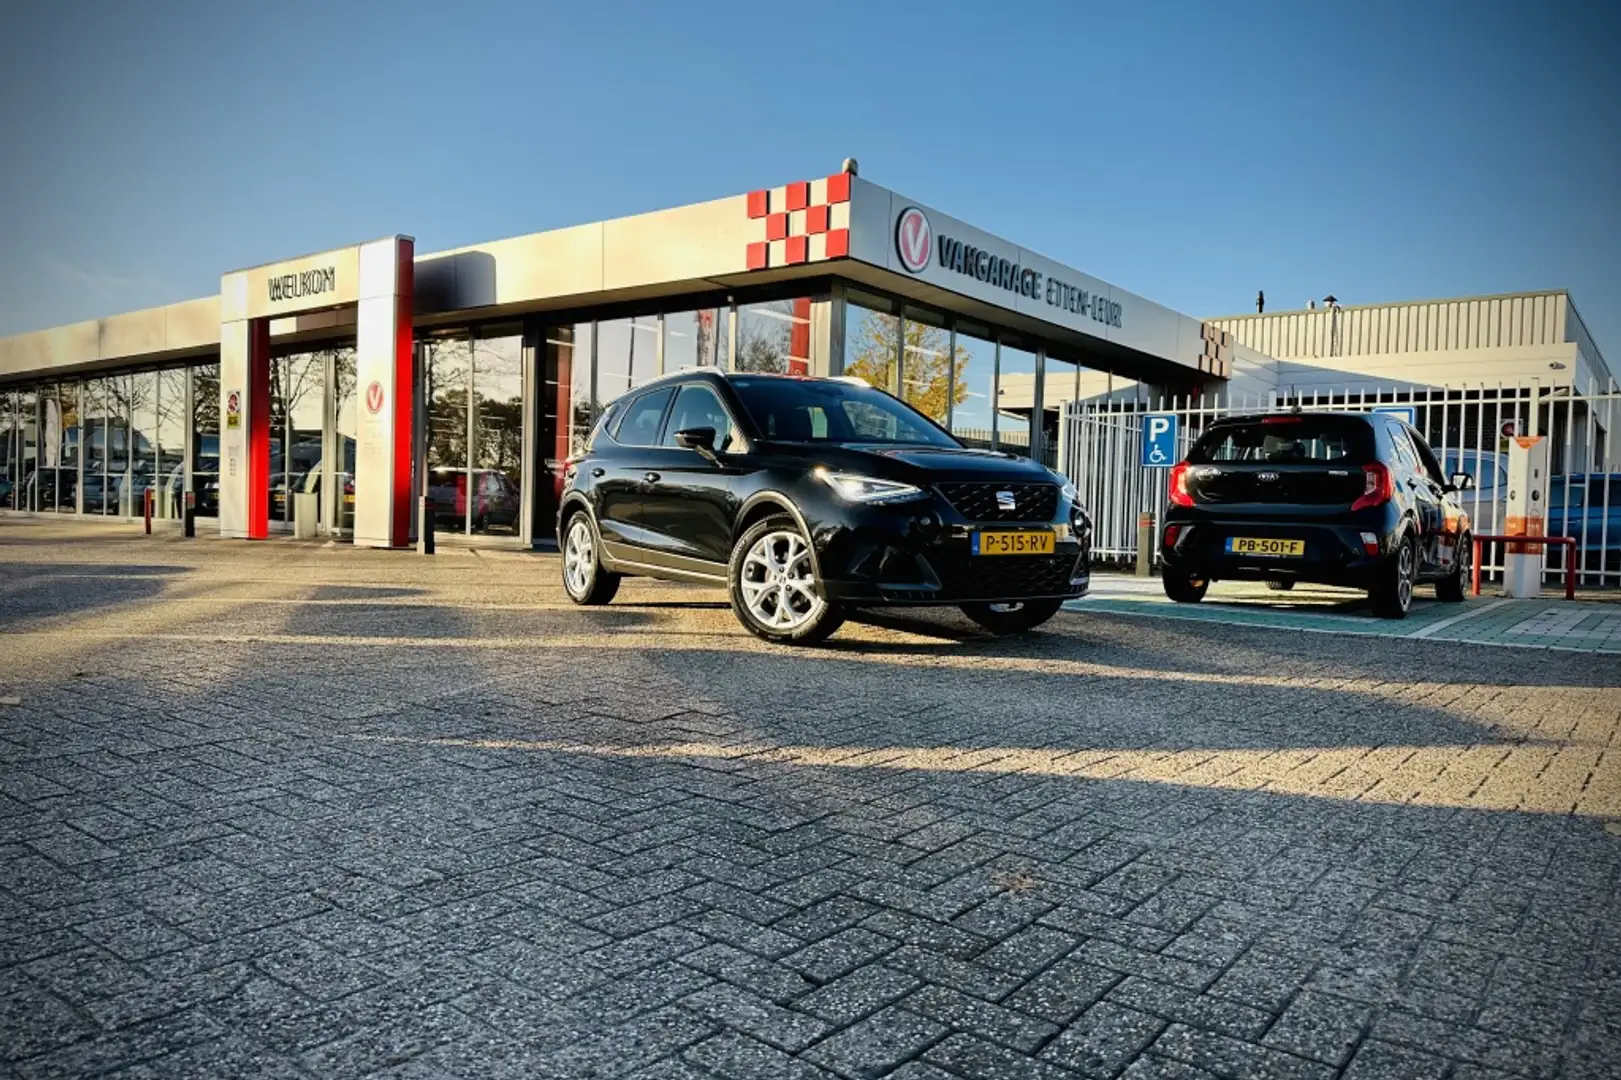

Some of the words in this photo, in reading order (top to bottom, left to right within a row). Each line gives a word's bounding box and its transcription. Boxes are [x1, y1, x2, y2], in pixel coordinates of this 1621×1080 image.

[268, 266, 335, 301] WELKOM
[938, 235, 1042, 300] VAKGARAGE
[1046, 277, 1122, 329] ETTEN-LEUR
[1149, 417, 1170, 442] P
[986, 535, 1048, 551] P-515-RV
[1239, 539, 1298, 553] PB-501-F
